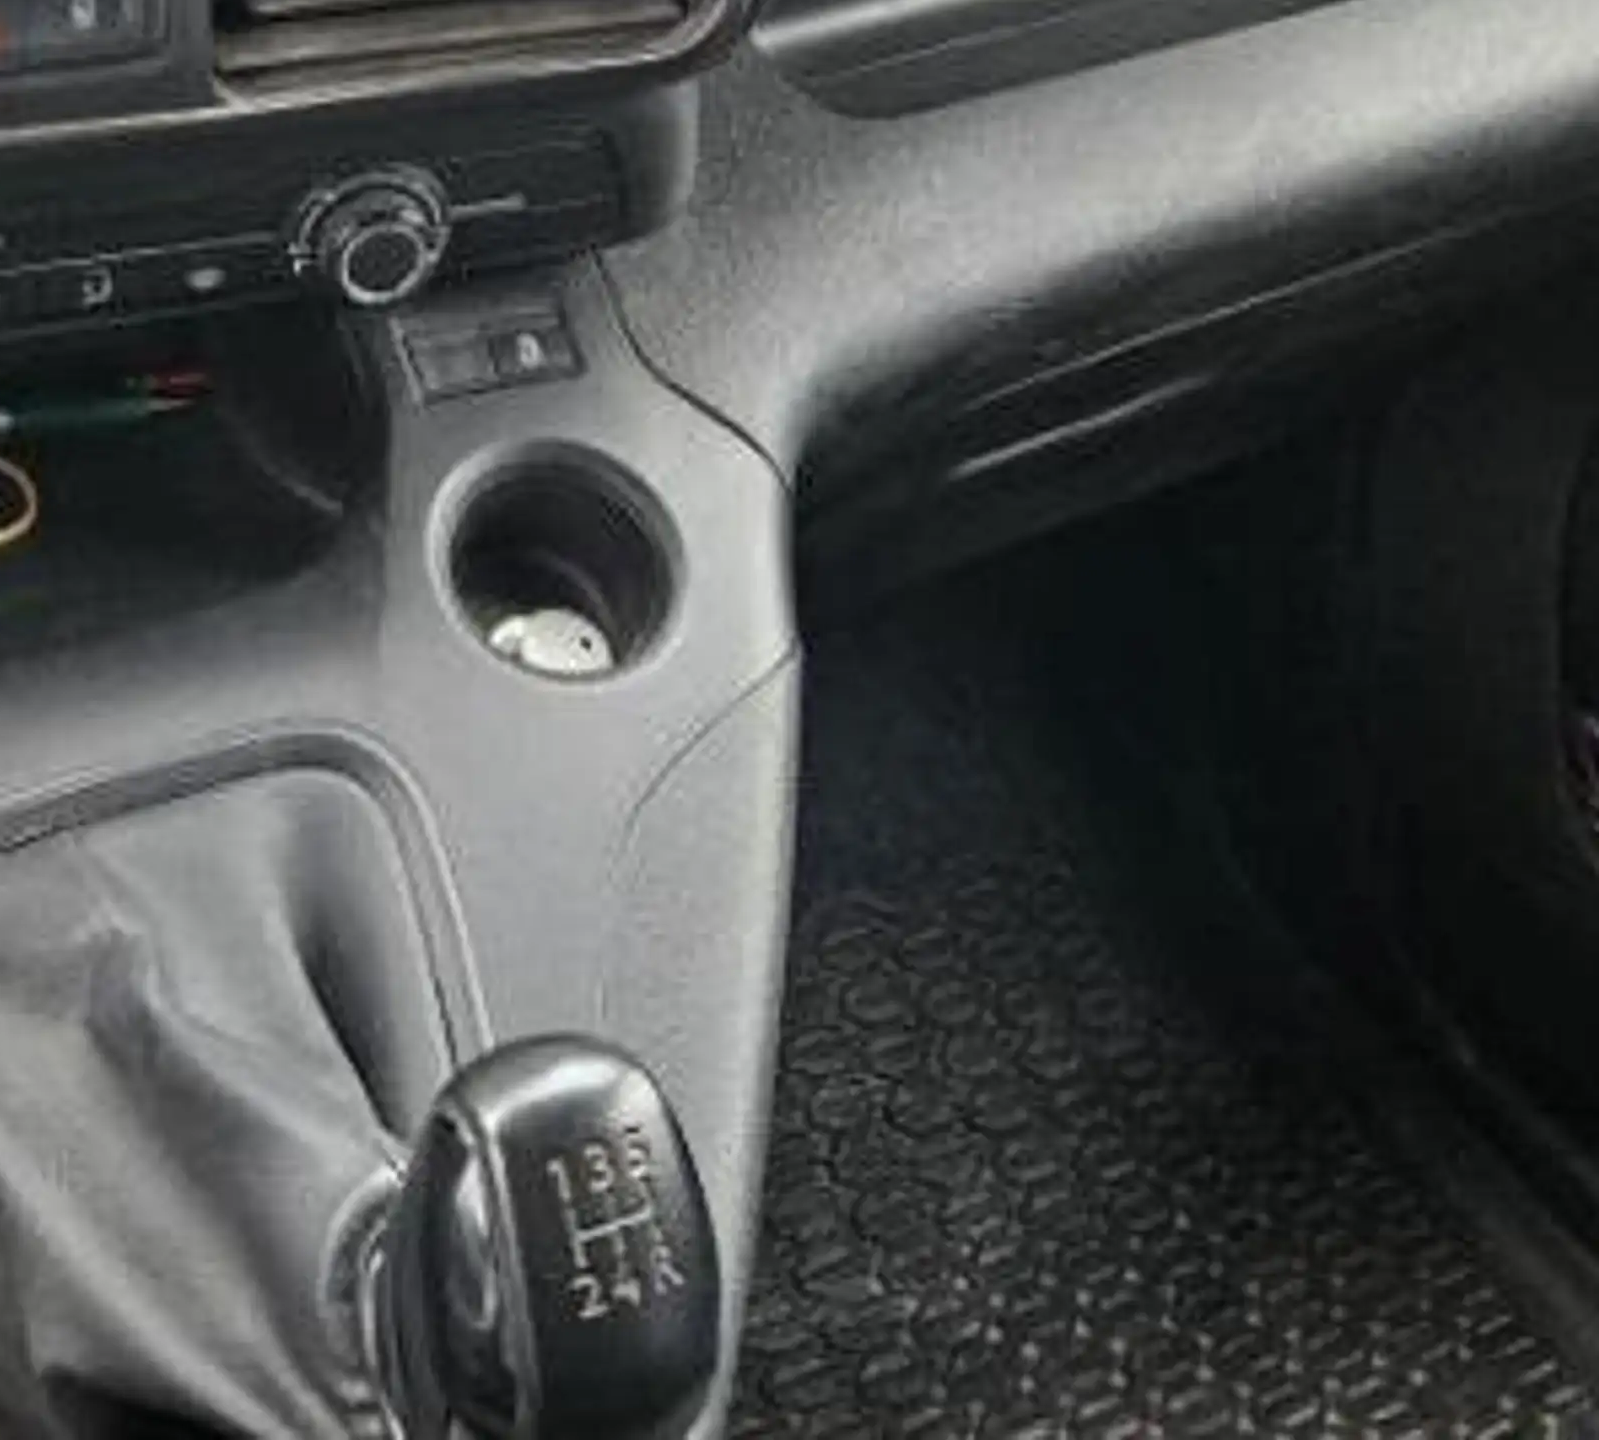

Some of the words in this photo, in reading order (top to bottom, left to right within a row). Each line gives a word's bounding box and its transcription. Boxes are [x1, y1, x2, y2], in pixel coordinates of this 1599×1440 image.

[546, 1157, 572, 1202] 1
[582, 1142, 614, 1193] 3
[568, 1273, 610, 1320] 2
[651, 1245, 686, 1296] R
